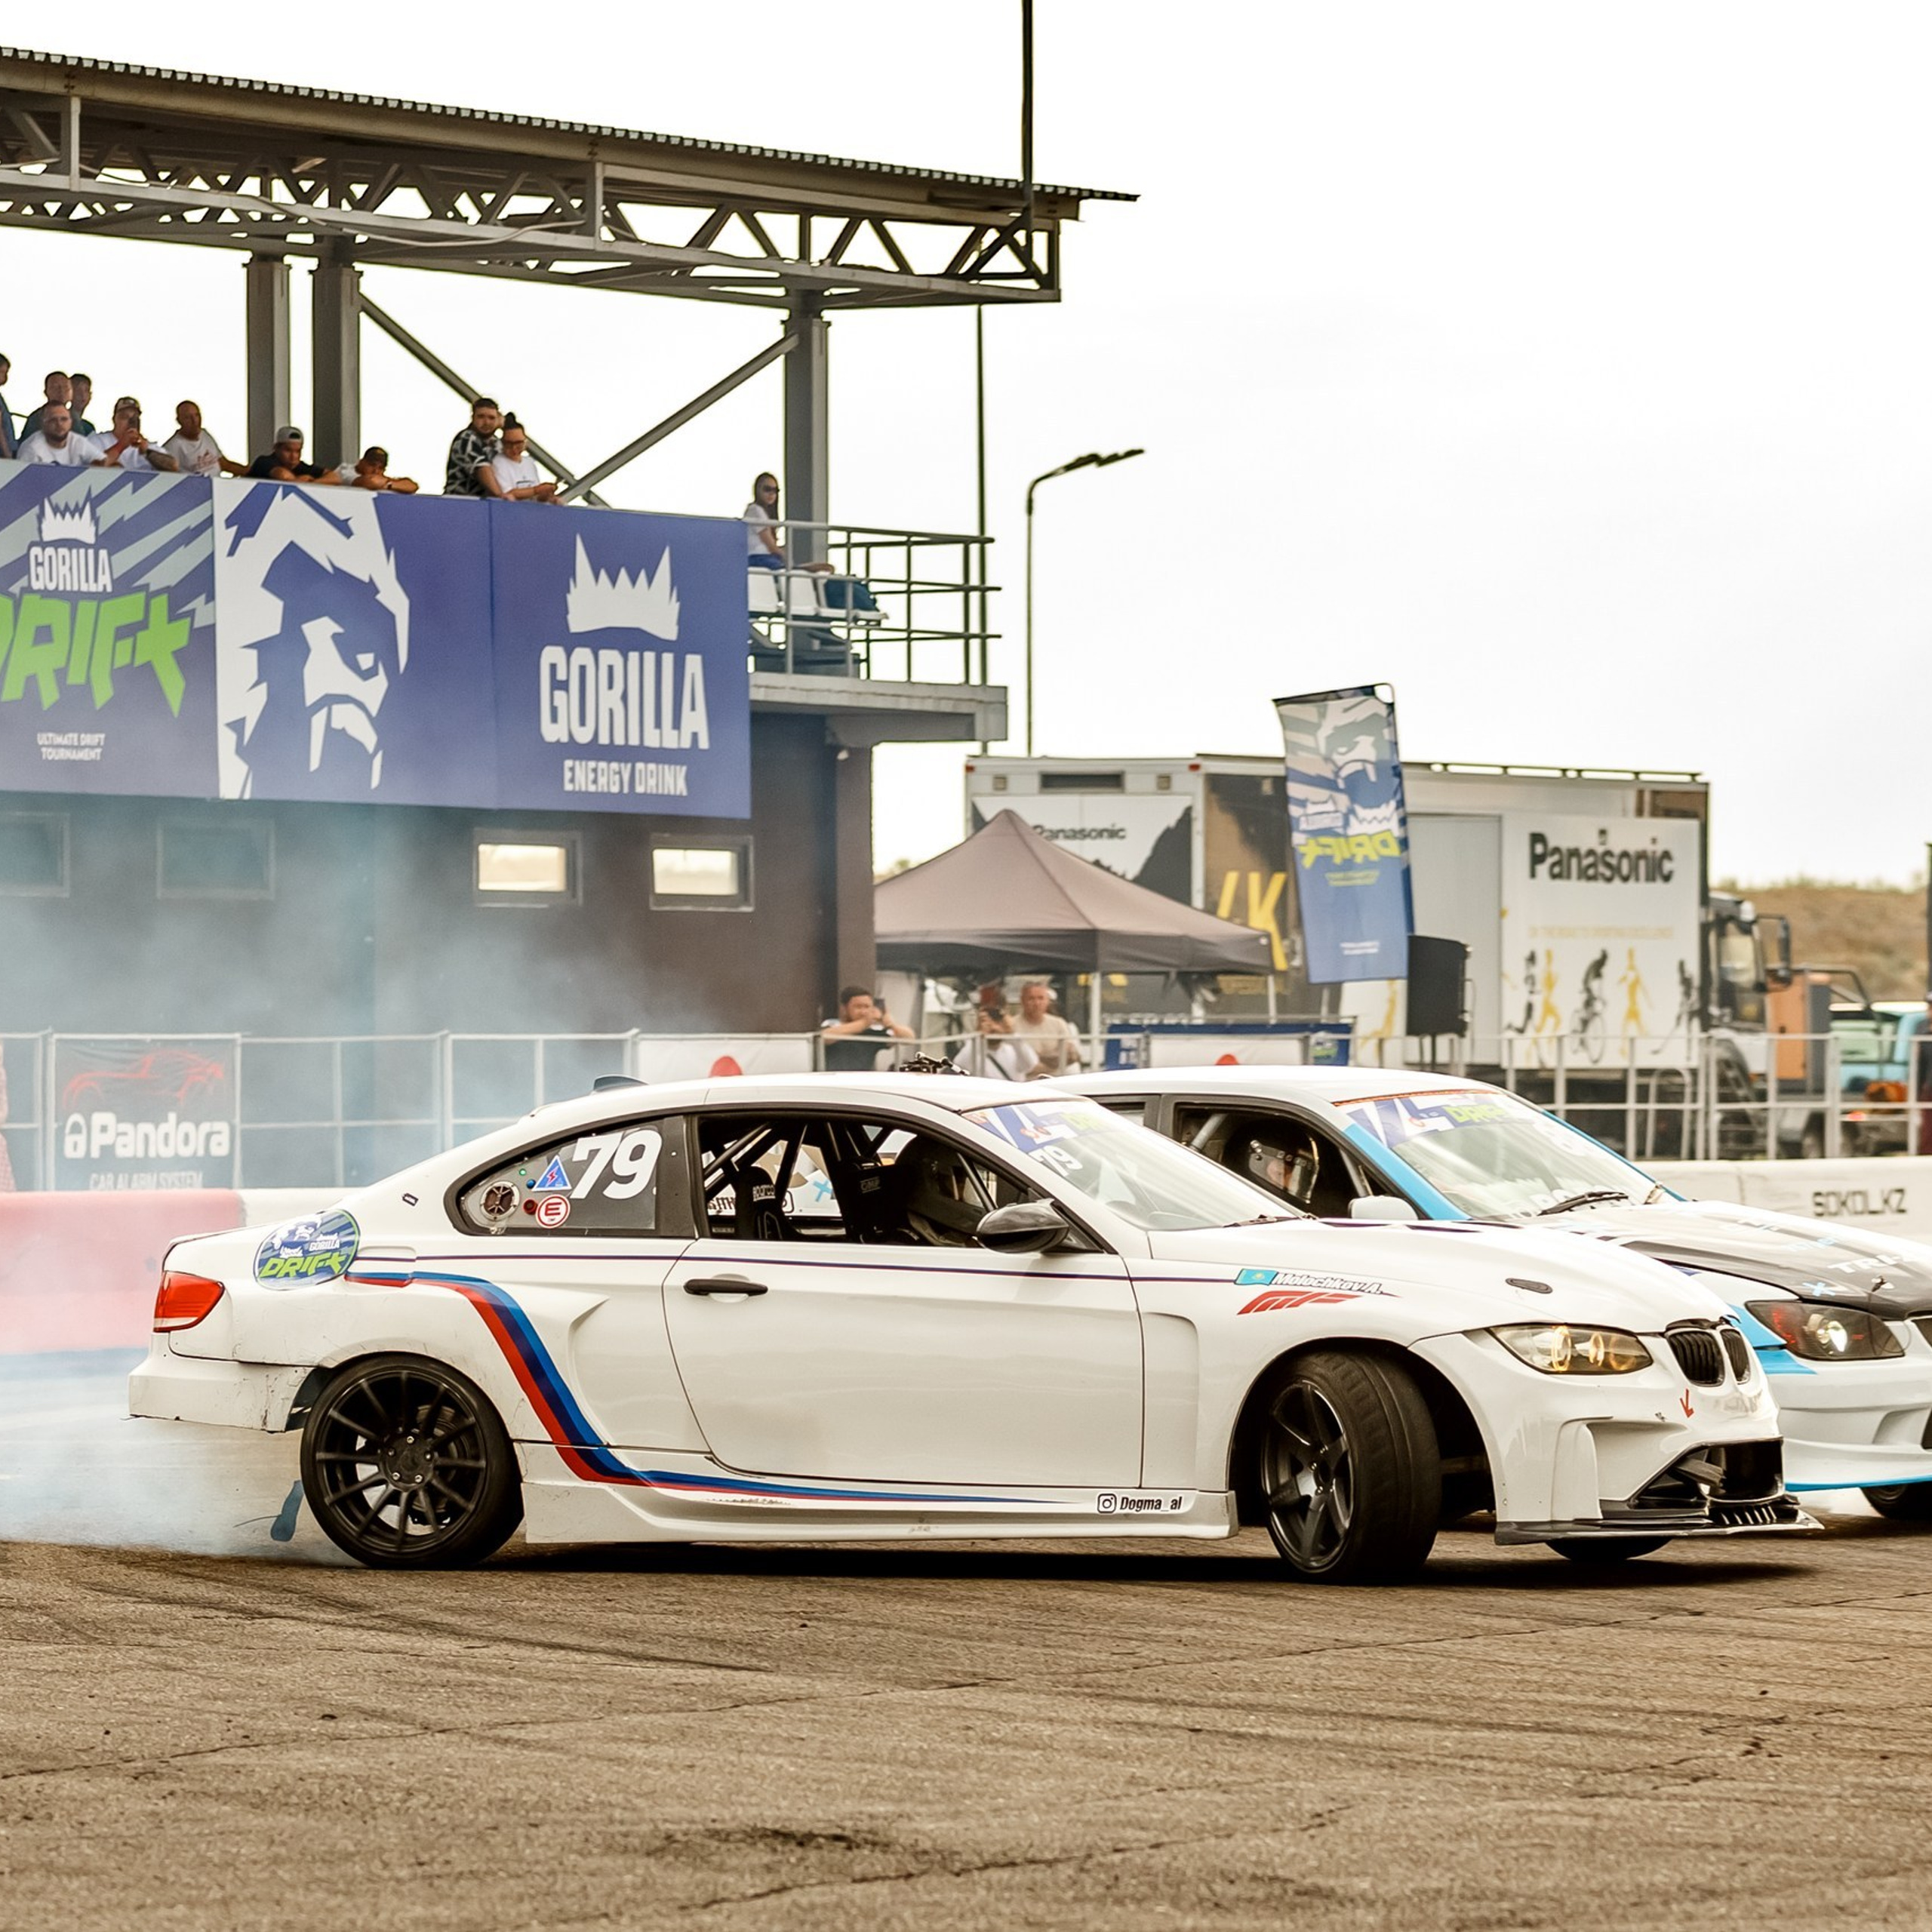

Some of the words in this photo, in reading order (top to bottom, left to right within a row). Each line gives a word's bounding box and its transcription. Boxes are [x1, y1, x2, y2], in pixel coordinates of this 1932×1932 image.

[29, 546, 112, 592] GORILLA
[540, 646, 709, 749] GORILLA
[41, 747, 102, 761] TOURNAMENT
[564, 759, 632, 794] ENERGY
[635, 763, 688, 796] DRINK
[1529, 832, 1674, 883] Panasonic
[90, 1112, 230, 1158] Pandora
[89, 1173, 114, 1189] CAR
[570, 1130, 663, 1200] 79
[1028, 1145, 1083, 1177] 79
[1119, 1496, 1183, 1512] Dogma_al
